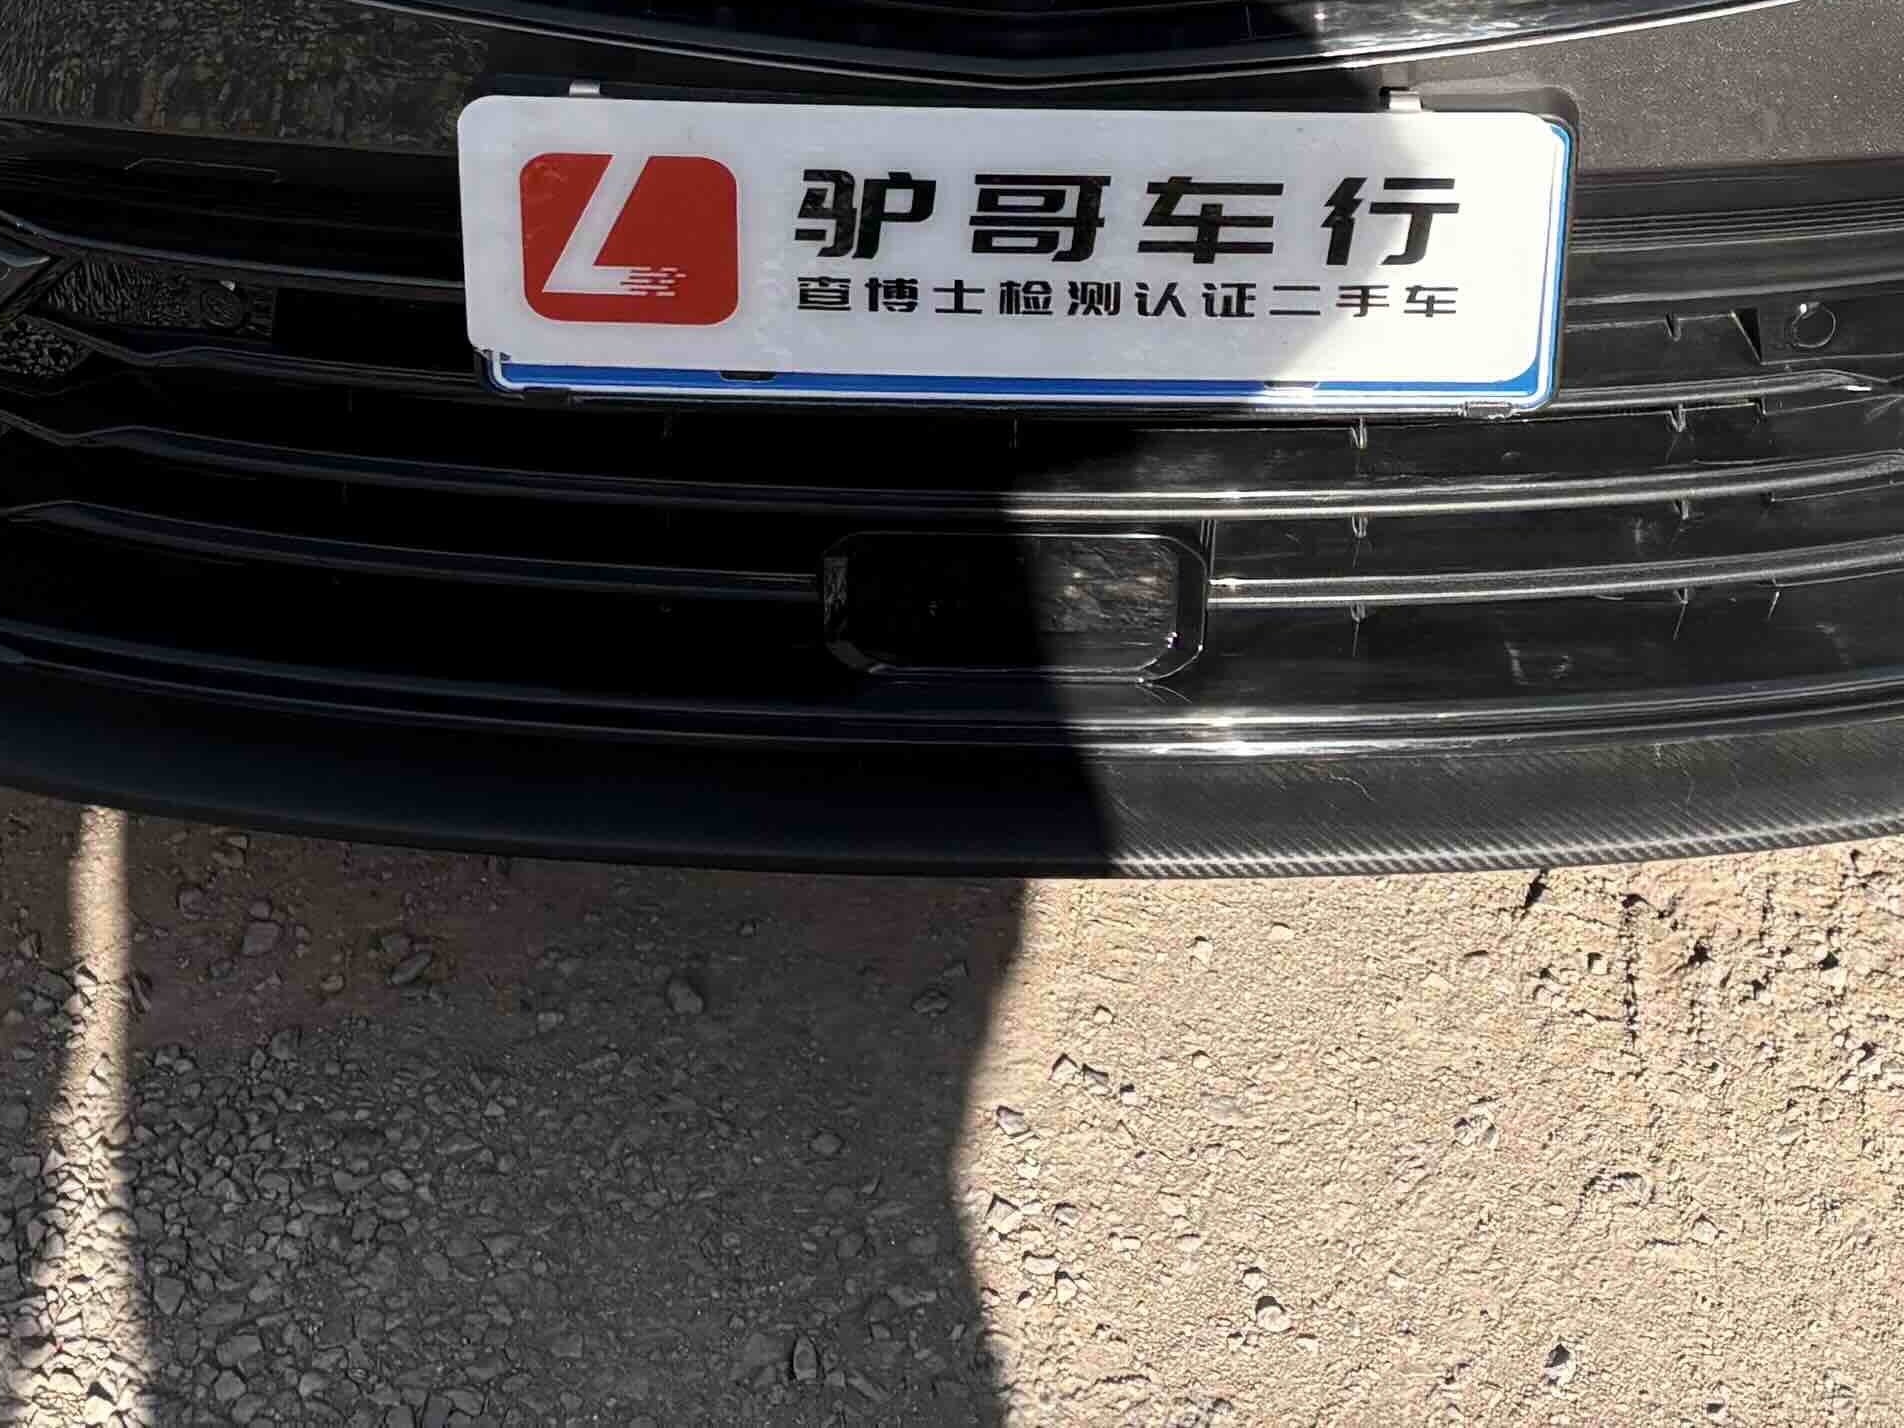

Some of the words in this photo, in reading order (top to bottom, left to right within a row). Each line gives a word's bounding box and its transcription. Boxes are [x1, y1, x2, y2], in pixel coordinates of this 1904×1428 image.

[794, 168, 1460, 266] 驴哥车行
[796, 276, 1459, 318] 查博士检测认证二手车
